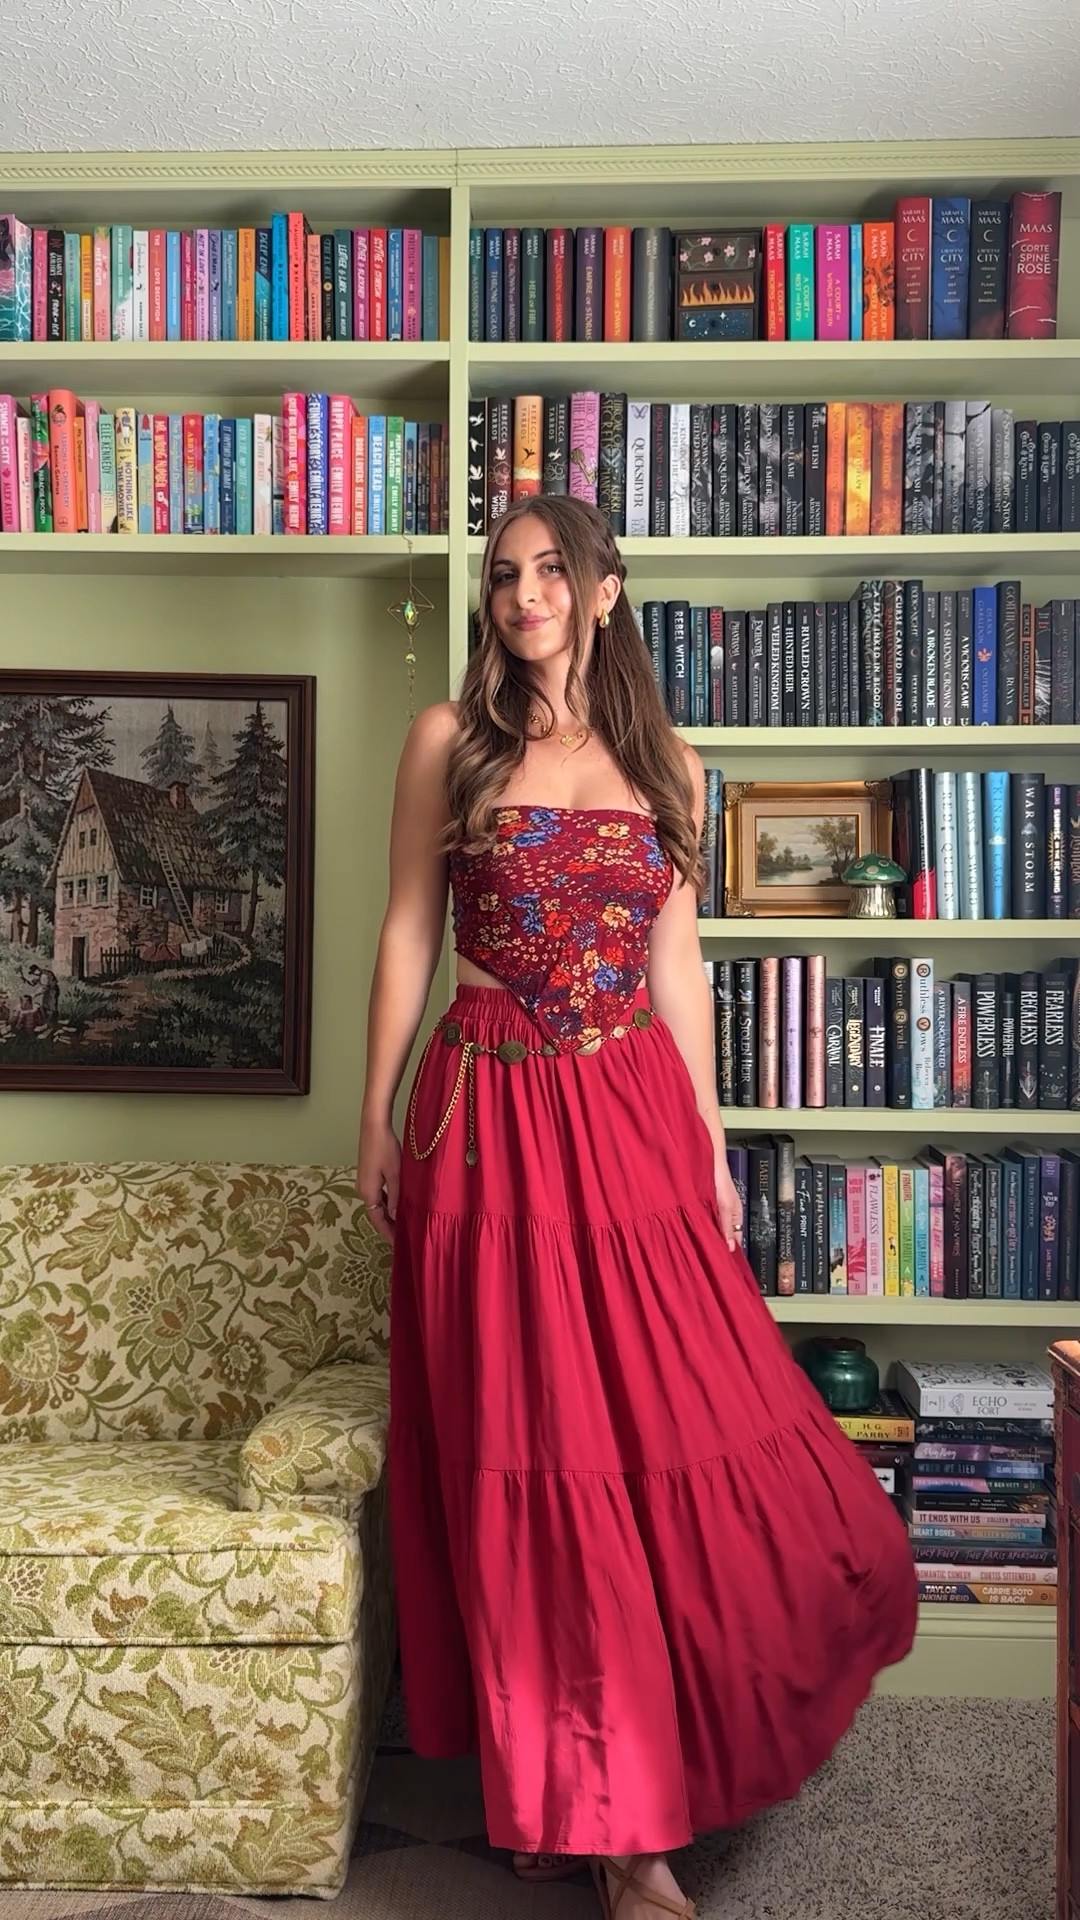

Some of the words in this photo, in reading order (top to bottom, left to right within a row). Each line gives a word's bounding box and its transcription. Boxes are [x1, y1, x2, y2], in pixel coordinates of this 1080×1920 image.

[338, 244, 347, 269] LEATHER
[902, 254, 924, 262] CITY
[941, 254, 963, 262] CITY
[977, 254, 999, 262] CITY
[1020, 254, 1049, 262] SPINE
[1021, 244, 1049, 252] CORTE
[1017, 263, 1051, 274] ROSE
[0, 402, 9, 435] SUMMER
[309, 403, 319, 432] FUNNY
[331, 401, 343, 429] HAPPY
[602, 400, 612, 448] SECRETS
[101, 424, 110, 439] ELLE
[102, 442, 111, 474] KENNEDY
[155, 435, 166, 458] WRONG
[310, 434, 320, 459] STORY
[332, 432, 343, 459] PLACE
[373, 436, 381, 465] BEACH
[125, 462, 133, 500] NOTHING
[155, 460, 167, 487] NUMBER
[311, 470, 321, 495] EMILY
[332, 467, 343, 493] EMILY
[373, 468, 381, 490] READ
[632, 438, 645, 507] QUICKSILVER
[3, 482, 11, 500] ALEX
[289, 481, 299, 502] EMILY
[355, 487, 363, 509] EMILY
[611, 485, 621, 512] KERRI
[4, 503, 12, 525] ASTER
[290, 505, 299, 527] HENRY
[311, 499, 321, 525] HENRY
[332, 497, 343, 524] HENRY
[491, 496, 499, 519] WING
[355, 512, 363, 534] HENRY
[675, 611, 683, 641] REBEL
[711, 614, 721, 644] BRIDE
[771, 626, 779, 662] VEILED
[785, 628, 793, 669] HUNTED
[801, 626, 809, 668] RIVALED
[927, 638, 935, 675] BROKEN
[676, 645, 684, 678] WITCH
[875, 663, 880, 672] IN
[961, 644, 969, 680] VICIOUS
[771, 663, 779, 709] KINGDOM
[801, 670, 809, 709] CROWN
[897, 674, 902, 683] IN
[944, 672, 952, 708] CROWN
[927, 677, 935, 708] BLADE
[961, 683, 969, 708] GAME
[943, 793, 951, 822] RED
[1026, 788, 1034, 818] WAR
[942, 843, 953, 902] QUEEN
[1025, 842, 1034, 892] STORM
[893, 964, 908, 1006] Divine
[917, 964, 931, 1014] Ruthless
[893, 1009, 909, 1050] Rivals
[976, 991, 995, 1058] POWERLESS
[1020, 991, 1038, 1045] RECKLESS
[1045, 990, 1064, 1045] FEARLESS
[741, 1018, 751, 1055] STOLEN
[827, 1025, 841, 1067] CARAVAL
[846, 1019, 862, 1067] LEGENDARY
[869, 1026, 885, 1067] FINALE
[917, 1017, 931, 1052] Vows
[958, 1027, 966, 1063] ENDLESS
[1003, 1018, 1014, 1057] POWERFUL
[742, 1060, 752, 1082] HEIR
[760, 1160, 768, 1193] BABEL
[902, 1173, 912, 1202] FANGIRL
[797, 1191, 810, 1213] Fine
[870, 1185, 879, 1234] FLAWLESS
[972, 1396, 1007, 1406] ECHO
[978, 1407, 1000, 1415] FORT
[913, 1528, 933, 1536] HEART
[934, 1529, 955, 1537] BONES
[920, 1514, 926, 1522] IT
[928, 1515, 947, 1523] ENDS
[949, 1515, 968, 1523] WITH
[970, 1515, 980, 1524] US
[916, 1550, 935, 1559] LUCY
[937, 1550, 959, 1560] FOLEY
[965, 1550, 980, 1560] THE
[982, 1550, 1005, 1560] PARIS
[1007, 1551, 1048, 1561] APARTMENT
[1003, 1571, 1036, 1581] SITTENFELD
[925, 1586, 957, 1594] TAYLOR
[982, 1587, 1010, 1595] CARRIE
[1000, 1596, 1026, 1604] BACK
